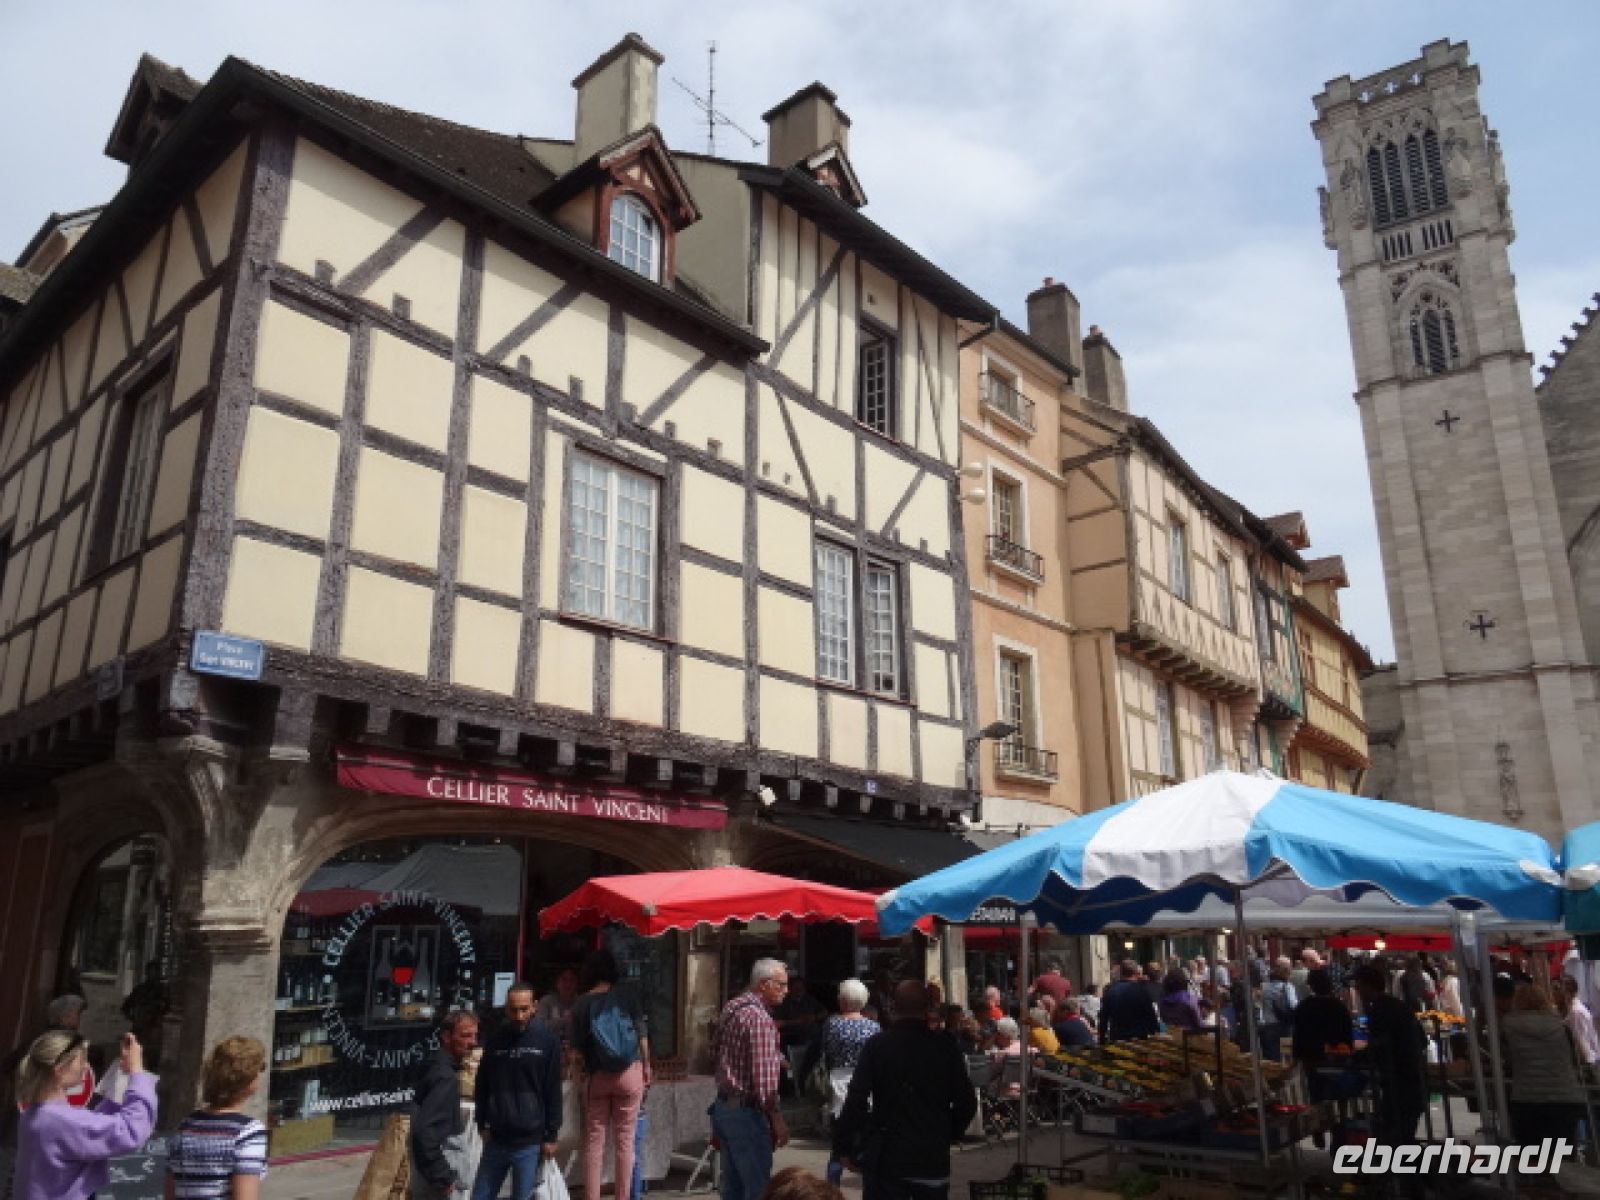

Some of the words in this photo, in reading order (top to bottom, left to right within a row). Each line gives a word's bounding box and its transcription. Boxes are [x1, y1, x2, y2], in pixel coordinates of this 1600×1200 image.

[426, 776, 510, 806] CELLIER
[521, 788, 580, 813] SAINT
[591, 796, 669, 823] VINCENT
[322, 901, 376, 966] CELLIER
